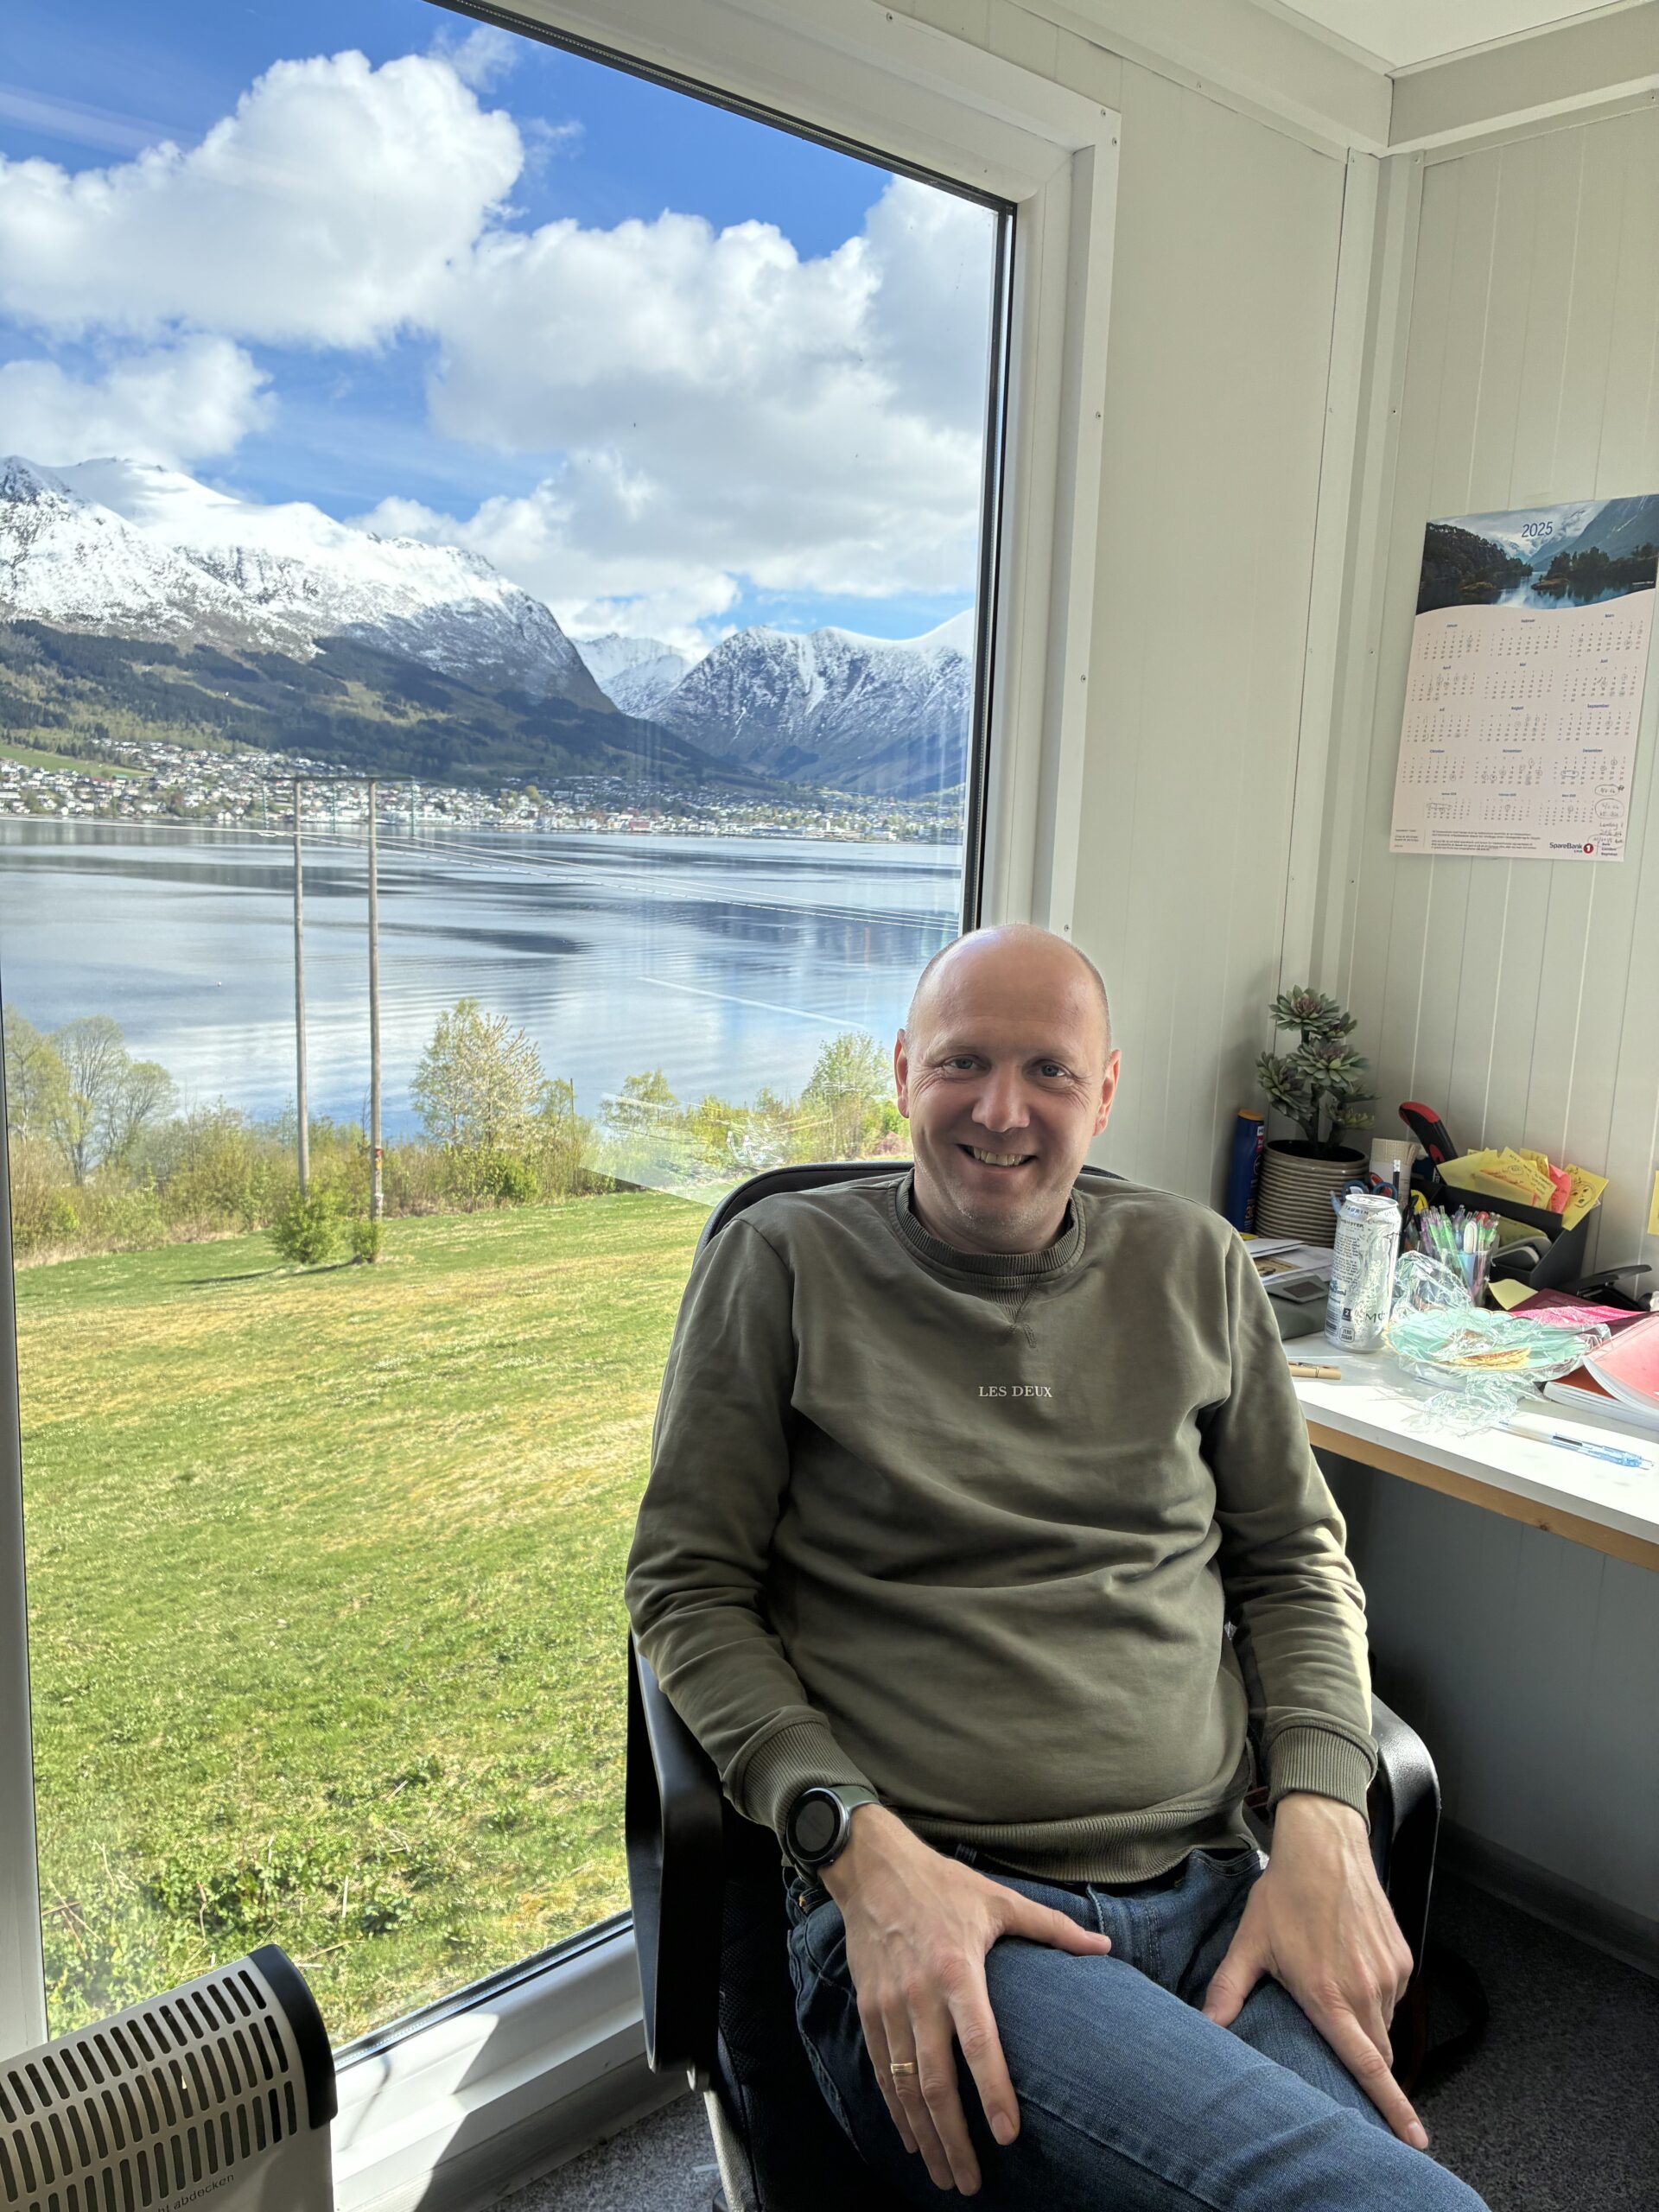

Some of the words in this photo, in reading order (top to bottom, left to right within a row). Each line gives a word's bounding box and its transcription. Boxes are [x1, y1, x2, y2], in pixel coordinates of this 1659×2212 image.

[1521, 521, 1553, 537] 2025
[978, 1386, 1007, 1397] LES
[1011, 1385, 1053, 1398] DEUX
[174, 2174, 234, 2210] abdecken
